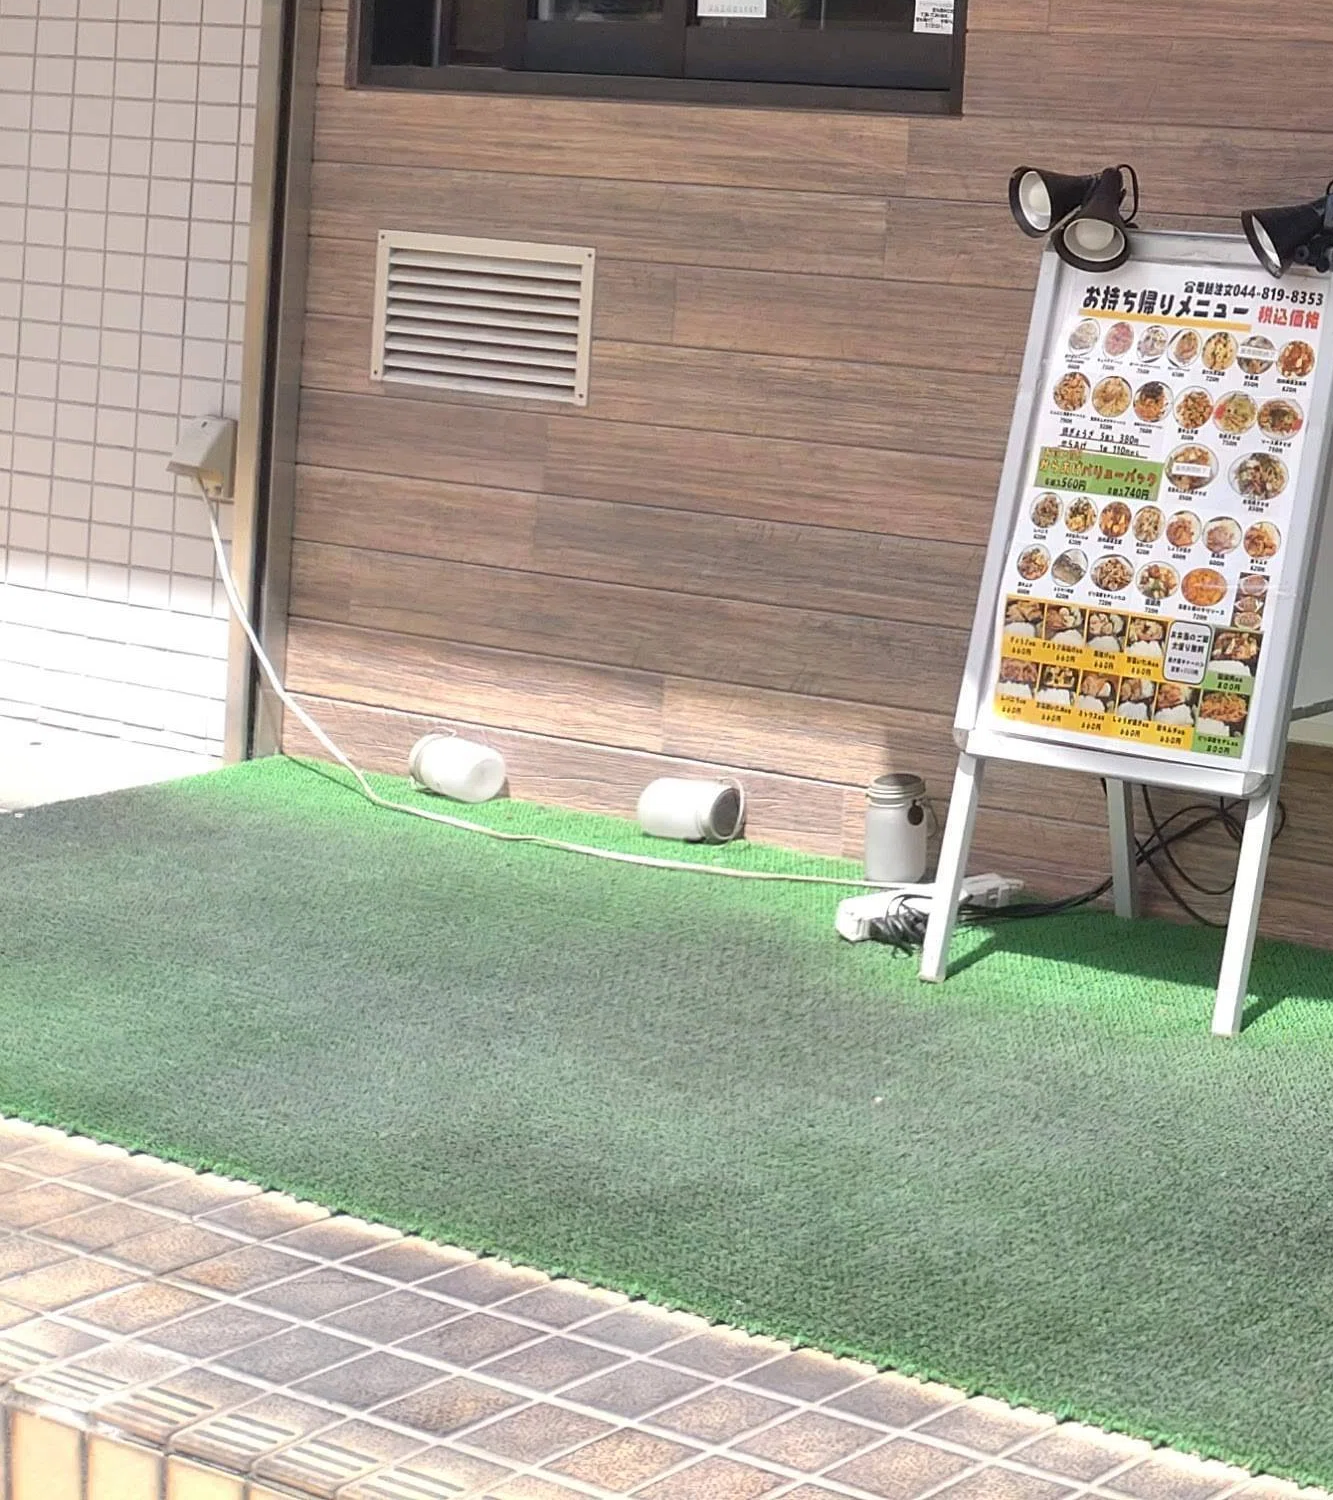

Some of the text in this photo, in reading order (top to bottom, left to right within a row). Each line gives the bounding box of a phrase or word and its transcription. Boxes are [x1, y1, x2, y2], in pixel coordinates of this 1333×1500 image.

[1082, 285, 1320, 330] お持ち帰りメニュー 税込価格
